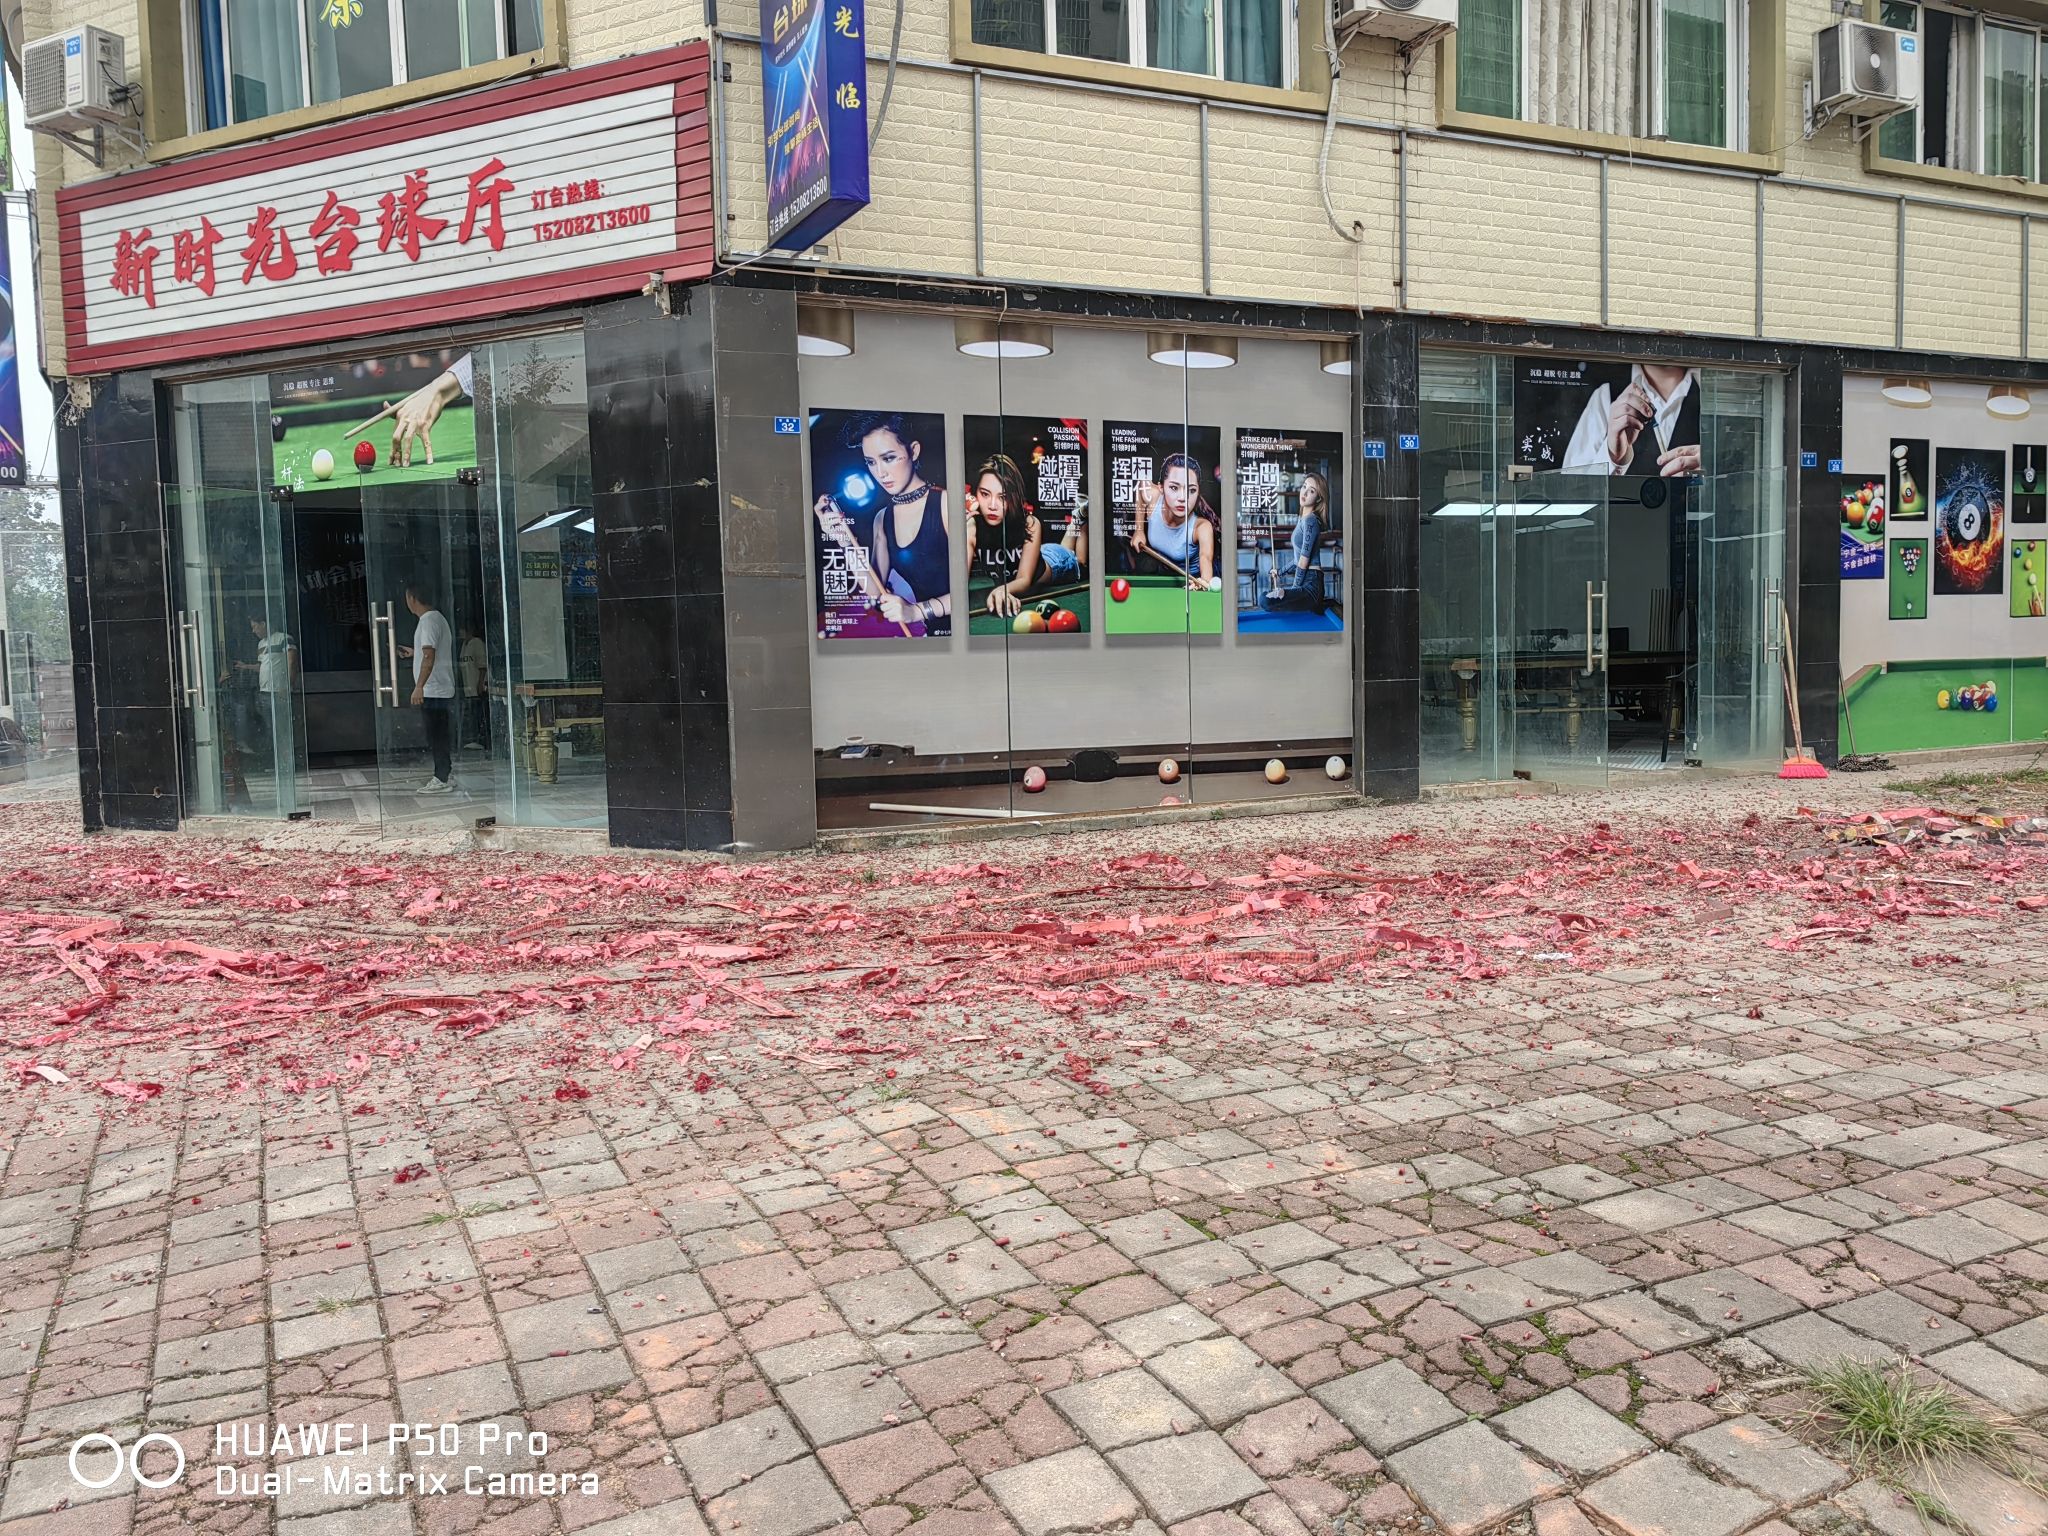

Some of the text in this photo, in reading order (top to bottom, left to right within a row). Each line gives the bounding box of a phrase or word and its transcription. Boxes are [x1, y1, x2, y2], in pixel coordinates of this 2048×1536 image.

[109, 156, 516, 310] 新时光台球厅
[533, 203, 651, 243] 15208213600
[781, 422, 795, 432] 32
[1047, 426, 1080, 434] COLLISION
[1053, 433, 1080, 441] PASSION
[1111, 428, 1137, 437] LEADING
[1053, 441, 1080, 450] 引领时尚
[1111, 444, 1137, 452] 引领时尚
[1240, 435, 1261, 443] STRIKE
[1404, 440, 1415, 448] 30
[1240, 450, 1265, 459] 引领时尚
[1038, 454, 1080, 479] 碰撞
[1112, 456, 1153, 480] 挥杆
[1241, 462, 1280, 487] 击出
[1038, 477, 1080, 502] 激情
[1112, 479, 1153, 502] 时代
[1241, 485, 1279, 508] 精彩
[823, 546, 869, 571] 无限
[823, 570, 869, 595] 魅力
